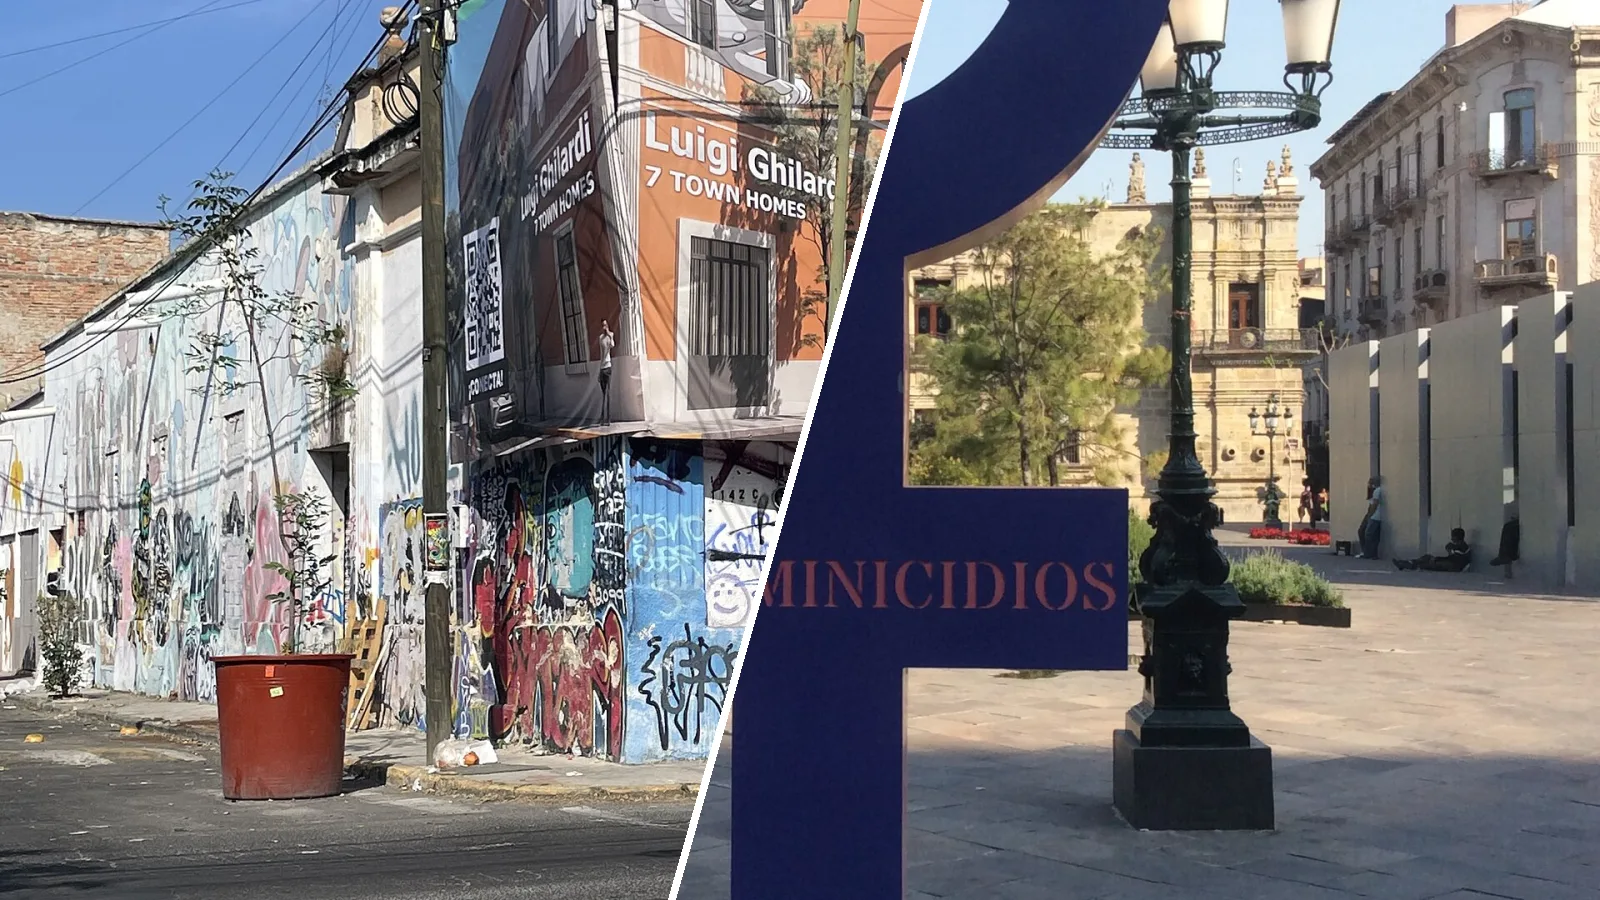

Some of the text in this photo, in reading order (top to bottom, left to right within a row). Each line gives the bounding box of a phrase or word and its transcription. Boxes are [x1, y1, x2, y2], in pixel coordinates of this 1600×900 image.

[521, 110, 592, 222] Luigi Ghilardi
[644, 110, 739, 176] Luigi
[538, 199, 559, 232] TOWN
[559, 170, 596, 215] HOMES
[644, 164, 807, 220] 7 TOWN HOMES
[763, 559, 1117, 612] MINICIDIOS
